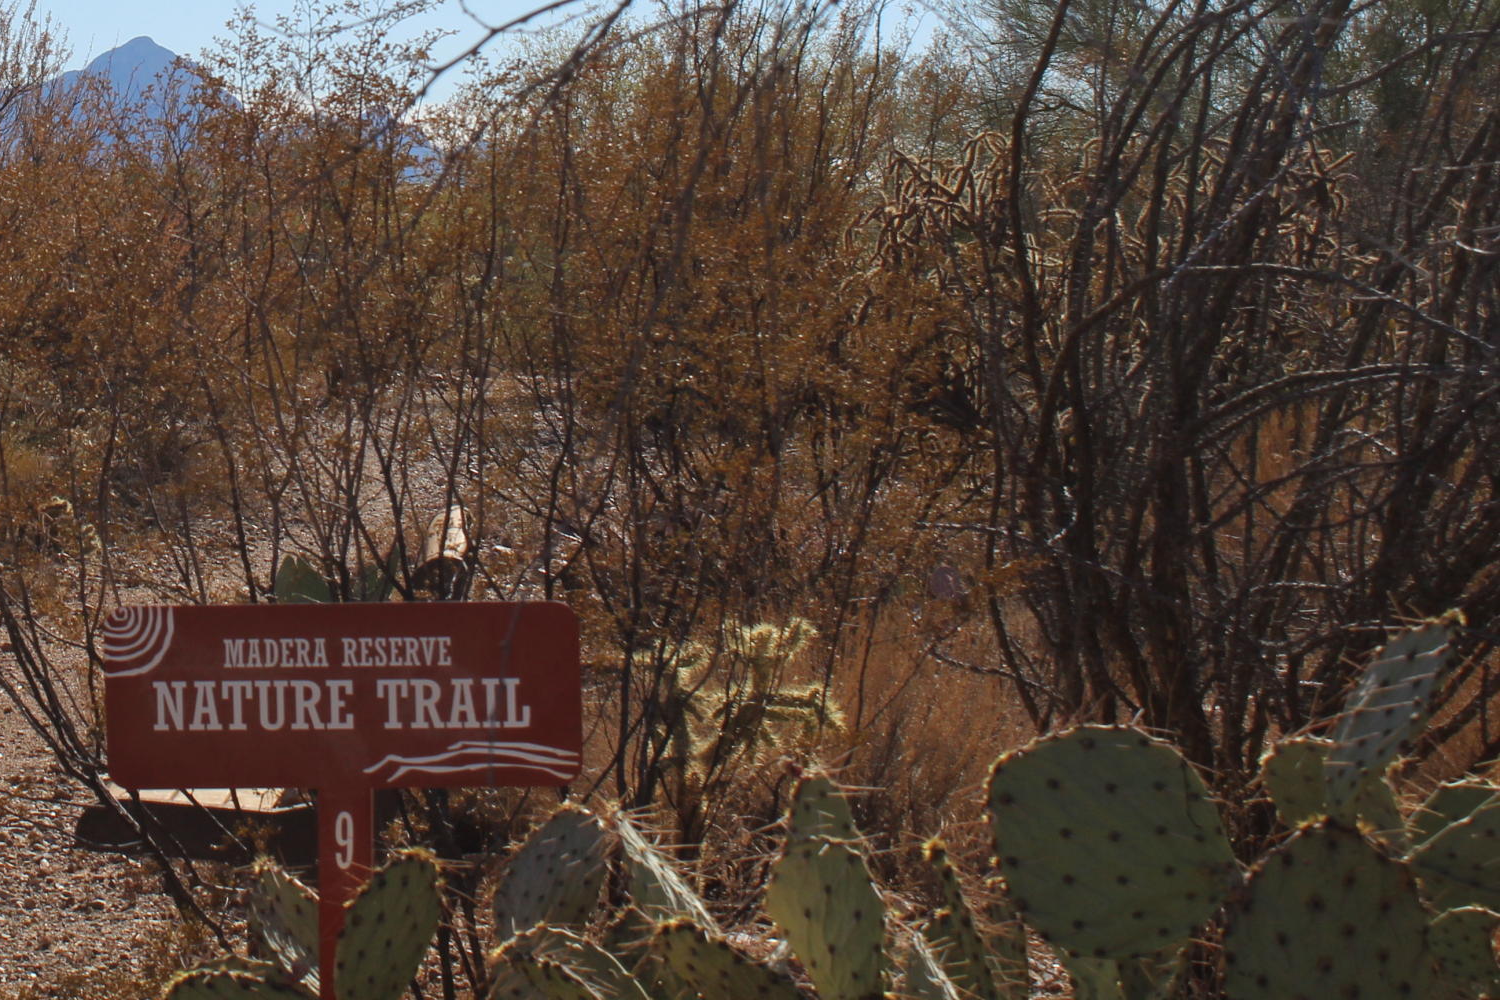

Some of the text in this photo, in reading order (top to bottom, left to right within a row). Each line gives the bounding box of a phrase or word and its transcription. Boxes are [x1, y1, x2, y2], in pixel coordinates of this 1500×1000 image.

[224, 636, 451, 668] MADERA RESERVE
[153, 678, 531, 731] NATURE TRAIL
[335, 811, 354, 869] 9
